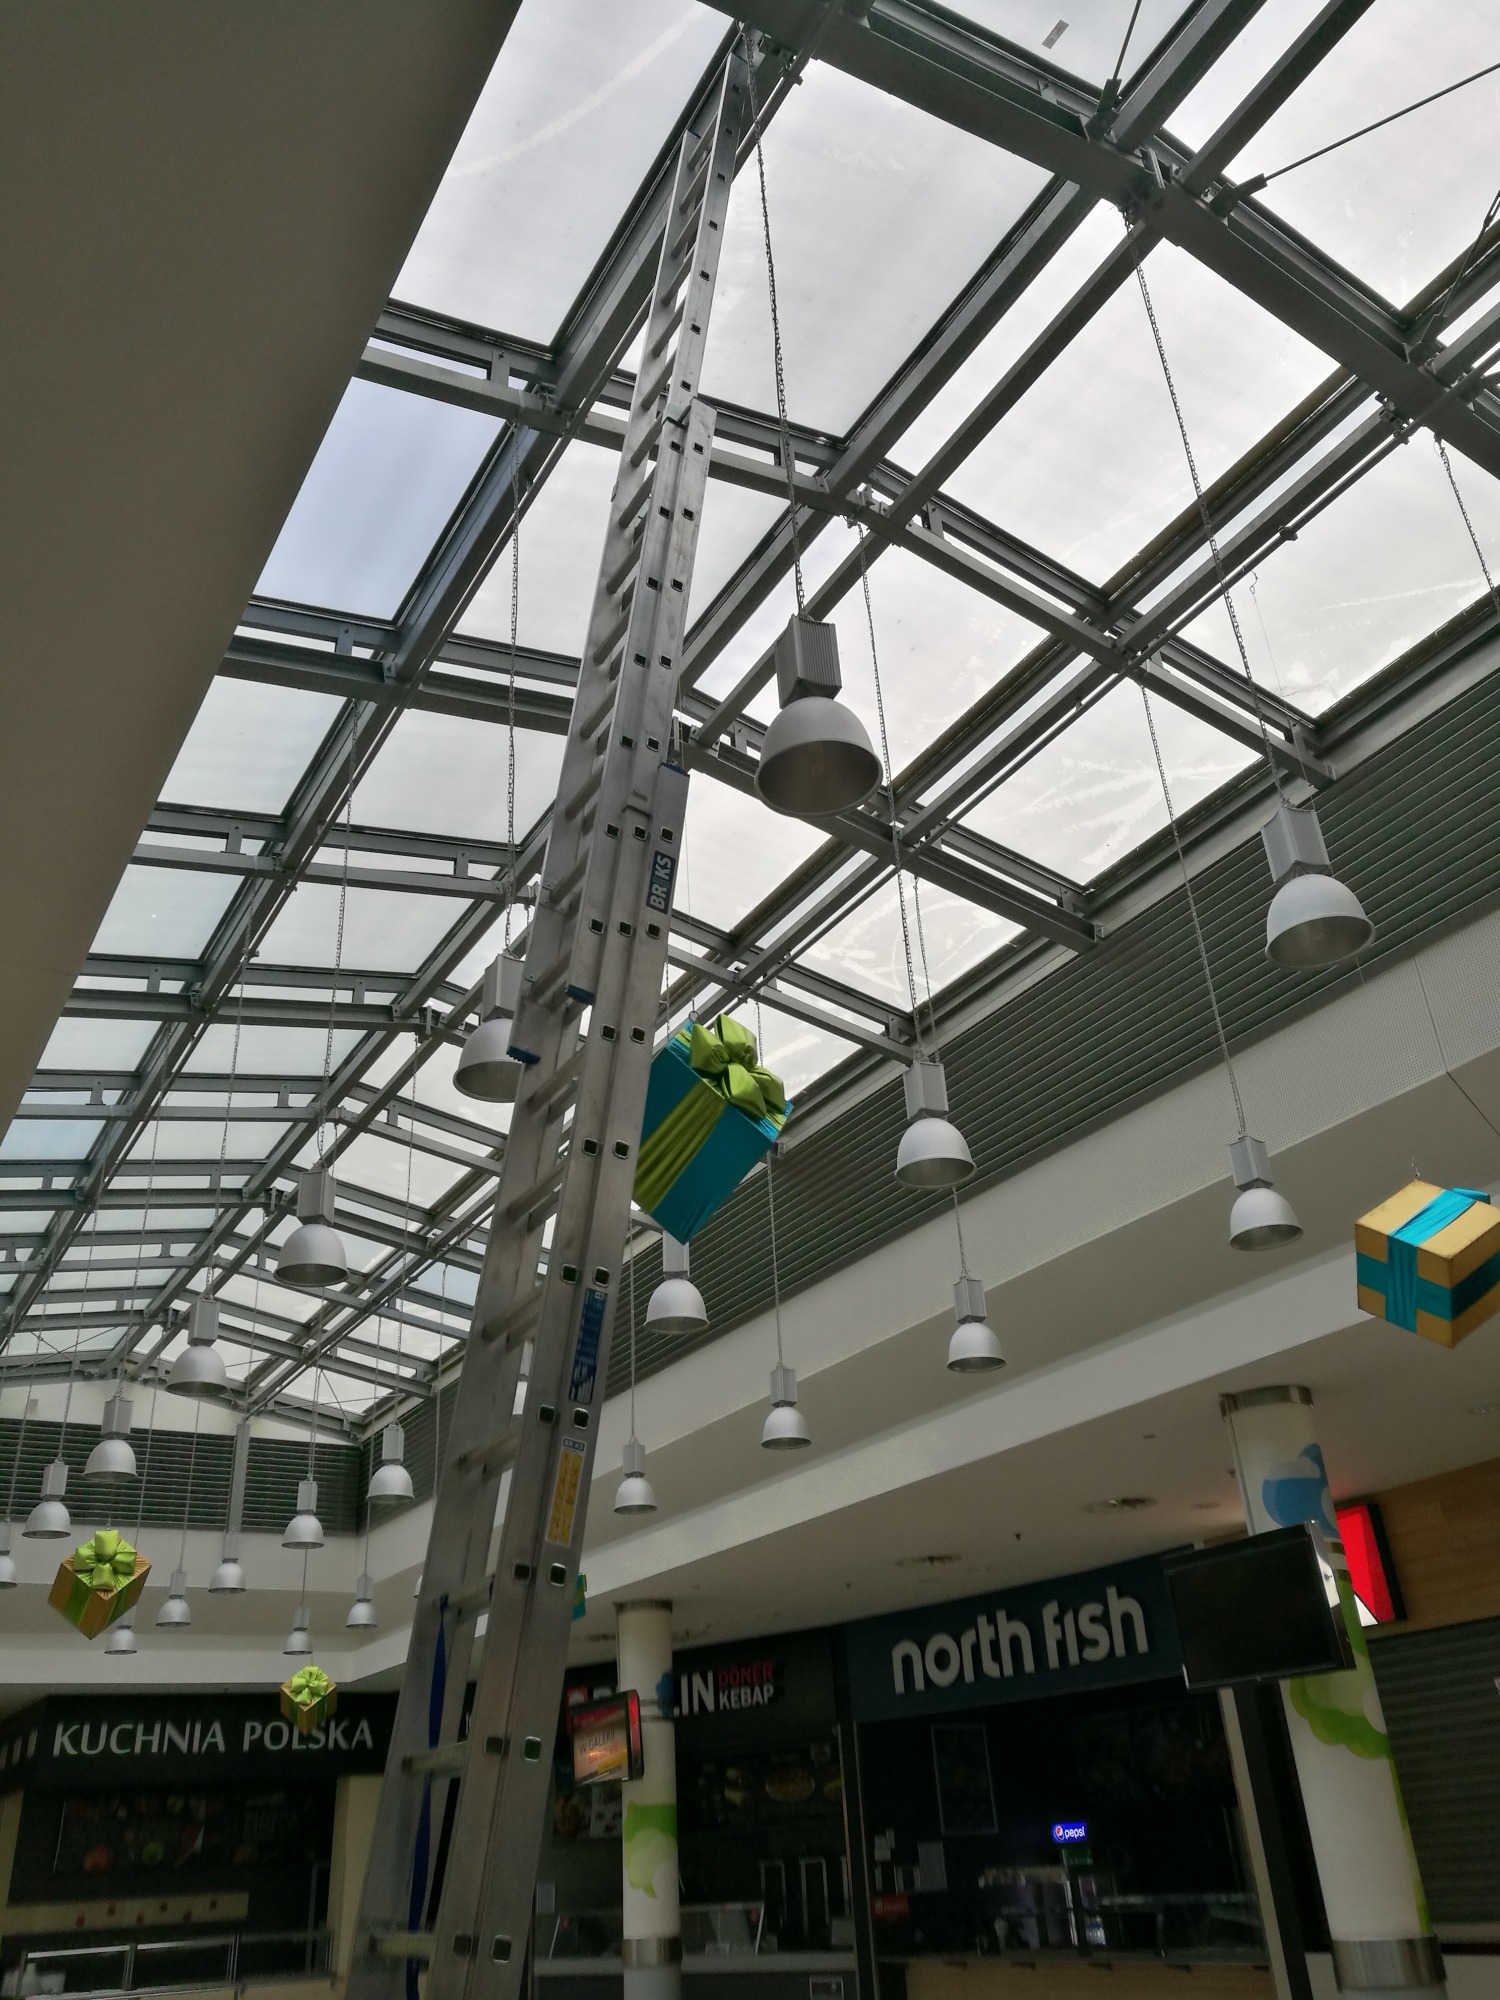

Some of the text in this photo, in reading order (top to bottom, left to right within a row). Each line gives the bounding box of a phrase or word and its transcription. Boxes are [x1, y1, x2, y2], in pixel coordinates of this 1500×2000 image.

[891, 1585, 1149, 1695] north fish
[718, 1682, 775, 1711] KEBAP
[52, 1718, 226, 1757] KUCHNIA
[242, 1717, 374, 1752] POLSKA
[1064, 1826, 1086, 1840] pepsi
